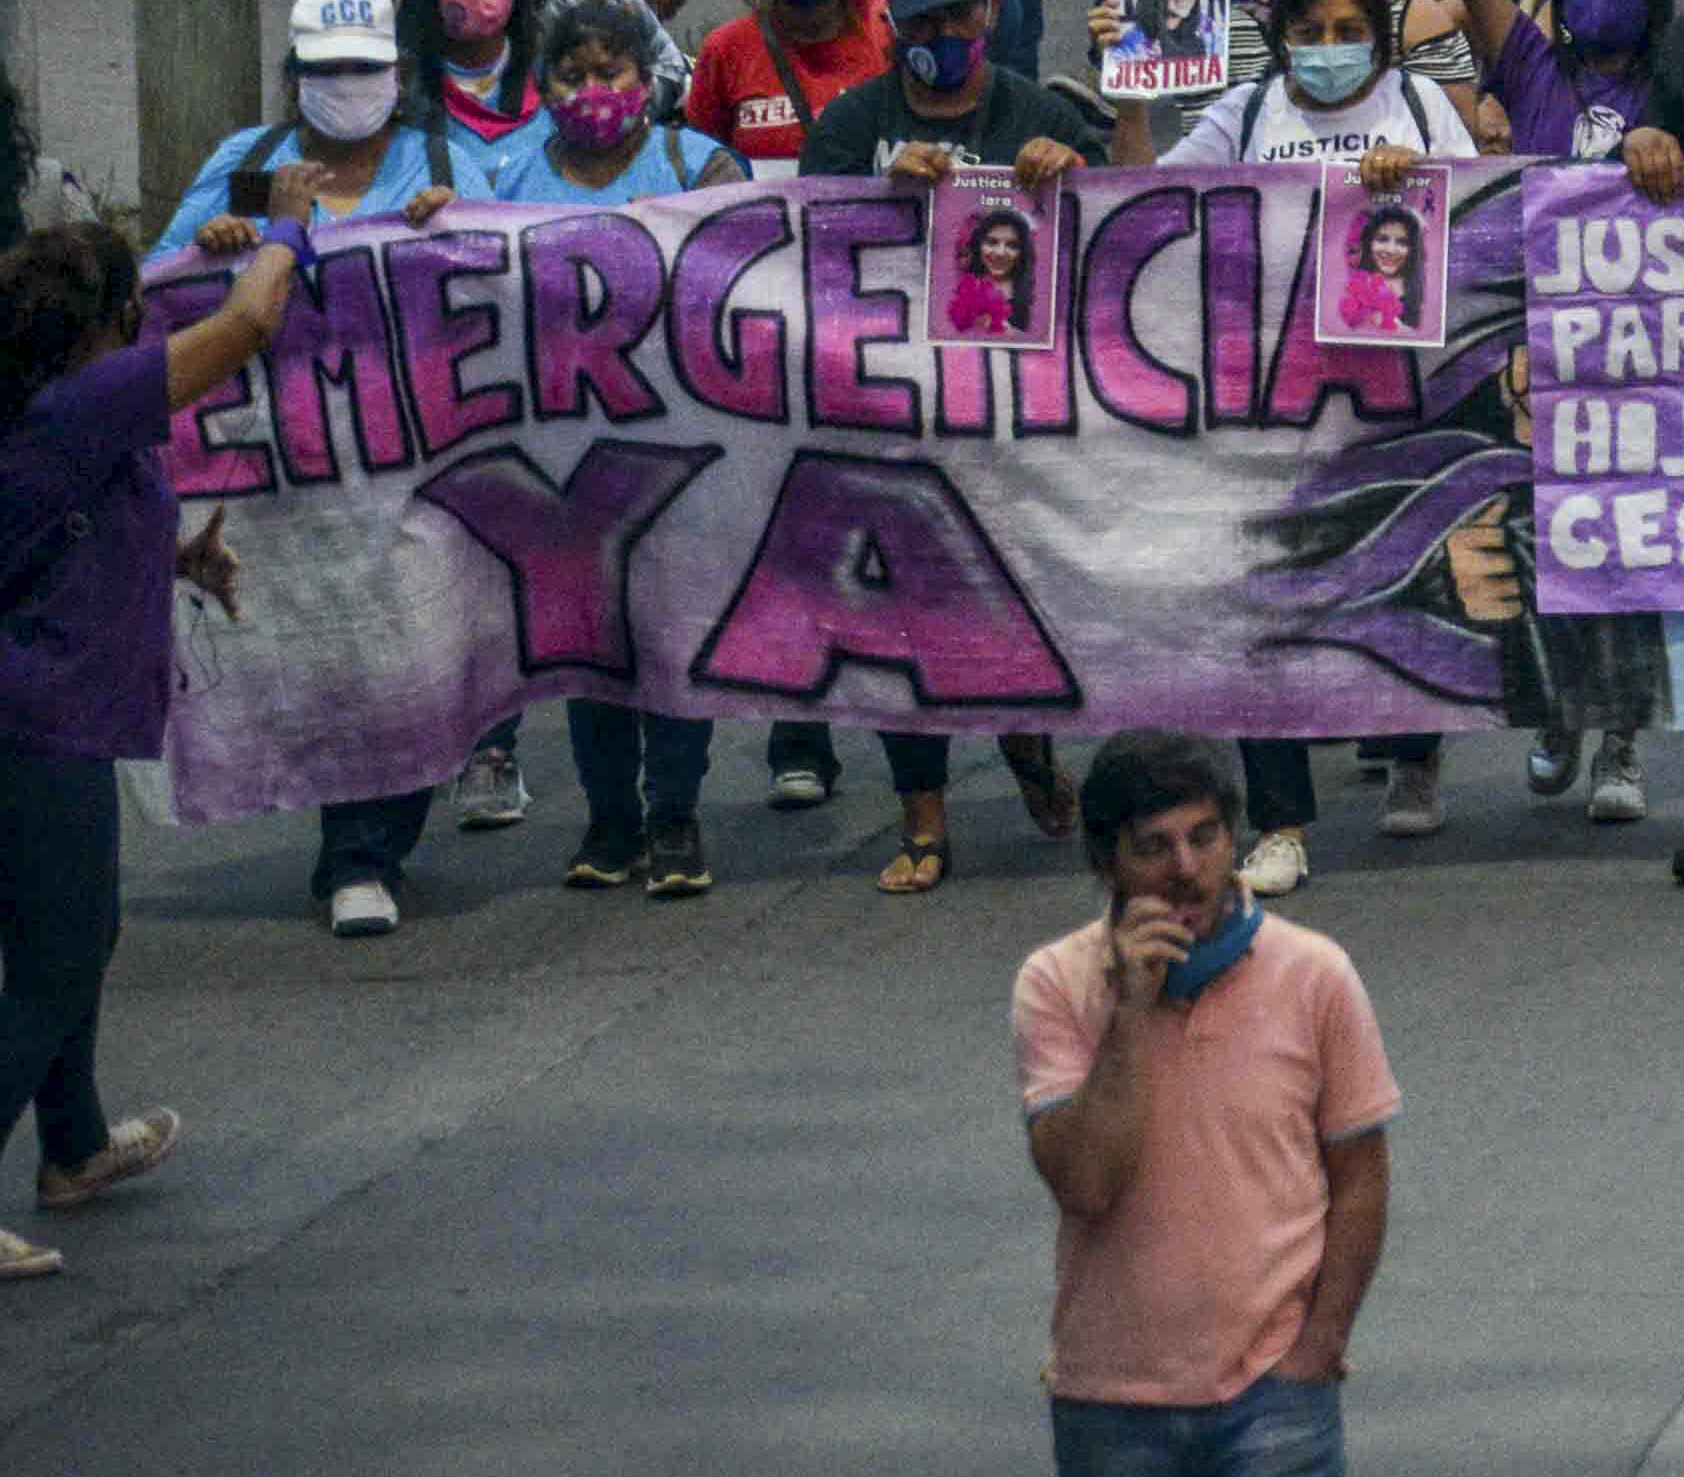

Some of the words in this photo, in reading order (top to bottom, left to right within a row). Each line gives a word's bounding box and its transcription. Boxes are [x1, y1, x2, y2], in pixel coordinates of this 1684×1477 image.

[1106, 51, 1224, 90] JUSTICIA
[1262, 132, 1388, 163] JUSTICIA
[952, 173, 1012, 191] Justicia
[413, 439, 1082, 710] YA
